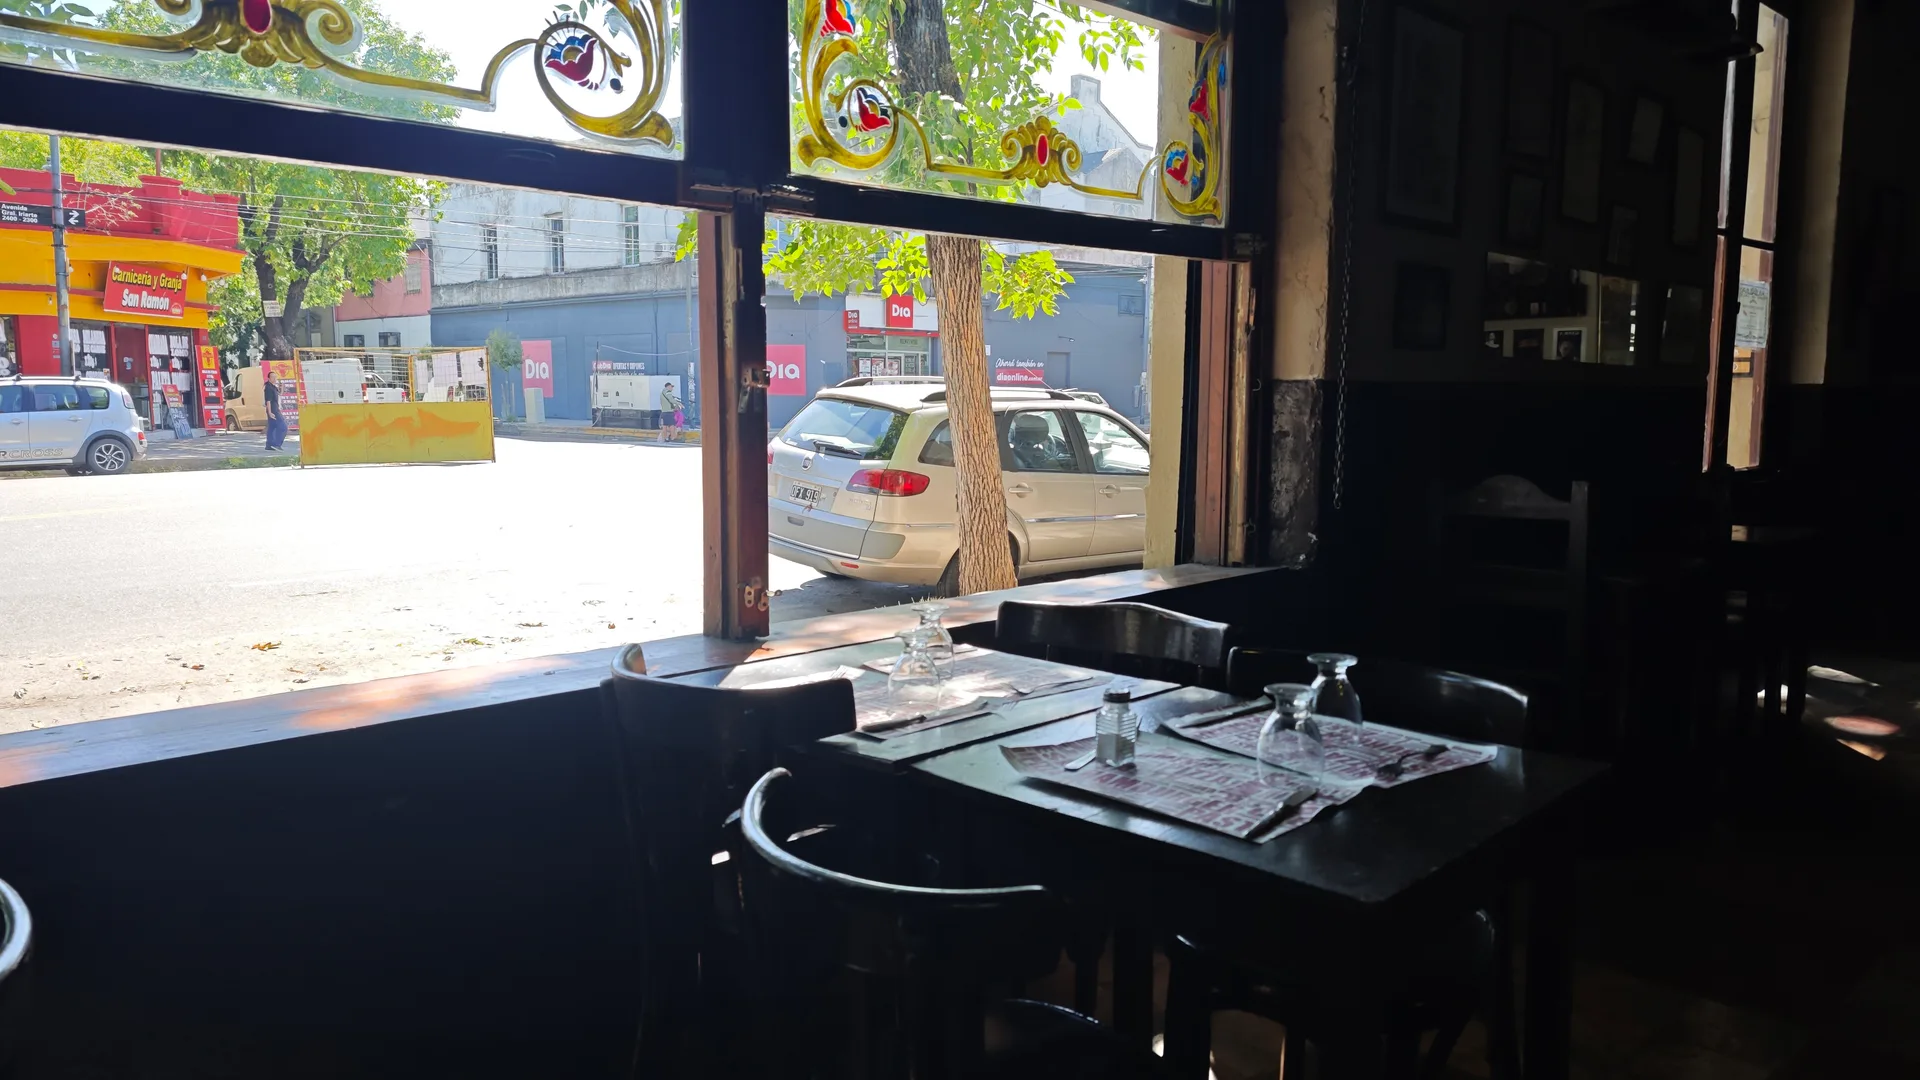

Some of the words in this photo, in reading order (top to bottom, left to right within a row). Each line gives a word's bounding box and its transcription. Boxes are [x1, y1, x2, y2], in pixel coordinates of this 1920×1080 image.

[1, 203, 28, 211] Avenida
[152, 275, 159, 290] y
[159, 273, 182, 292] Granja
[121, 288, 140, 307] San
[140, 290, 170, 310] Ramón
